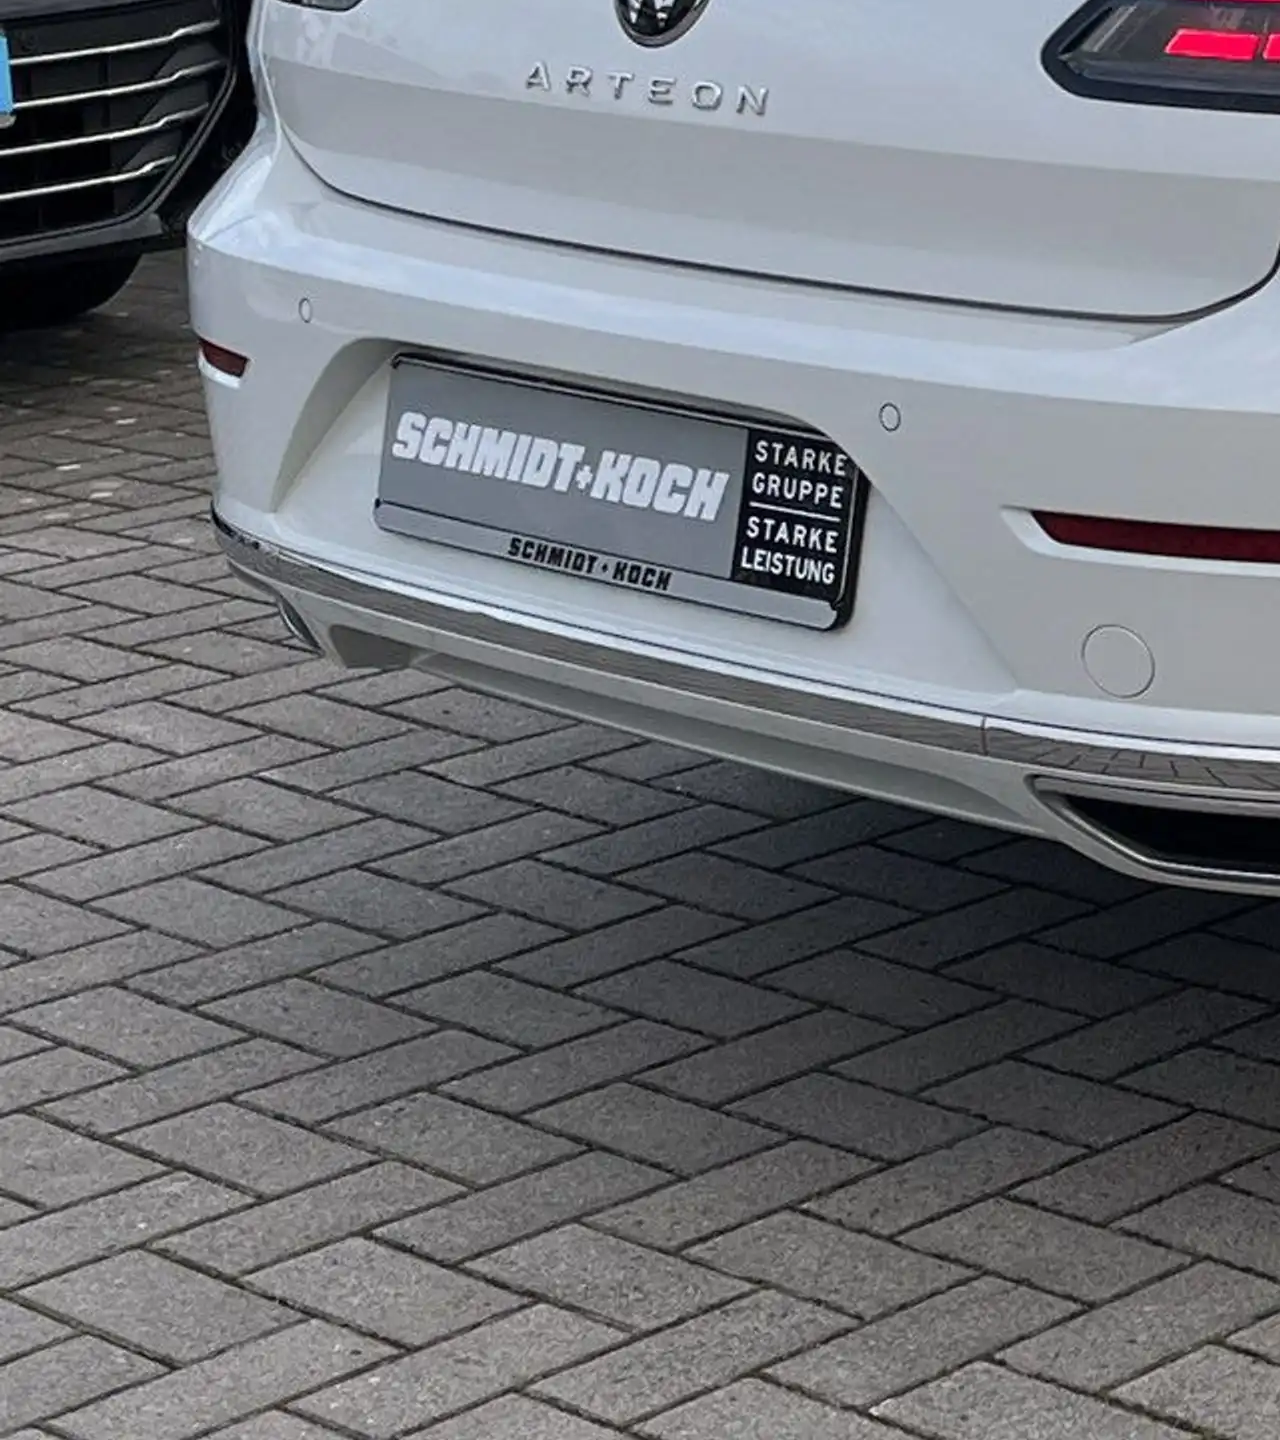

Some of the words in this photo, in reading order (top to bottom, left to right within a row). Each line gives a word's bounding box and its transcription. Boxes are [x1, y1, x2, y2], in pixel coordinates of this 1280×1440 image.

[525, 60, 770, 116] ARTEON
[391, 411, 730, 522] SCHMIDT+KOCH
[754, 439, 848, 476] STARKE
[751, 471, 844, 509] GRUPPE
[746, 515, 839, 554] STARKE
[740, 545, 836, 585] LEISTUNG
